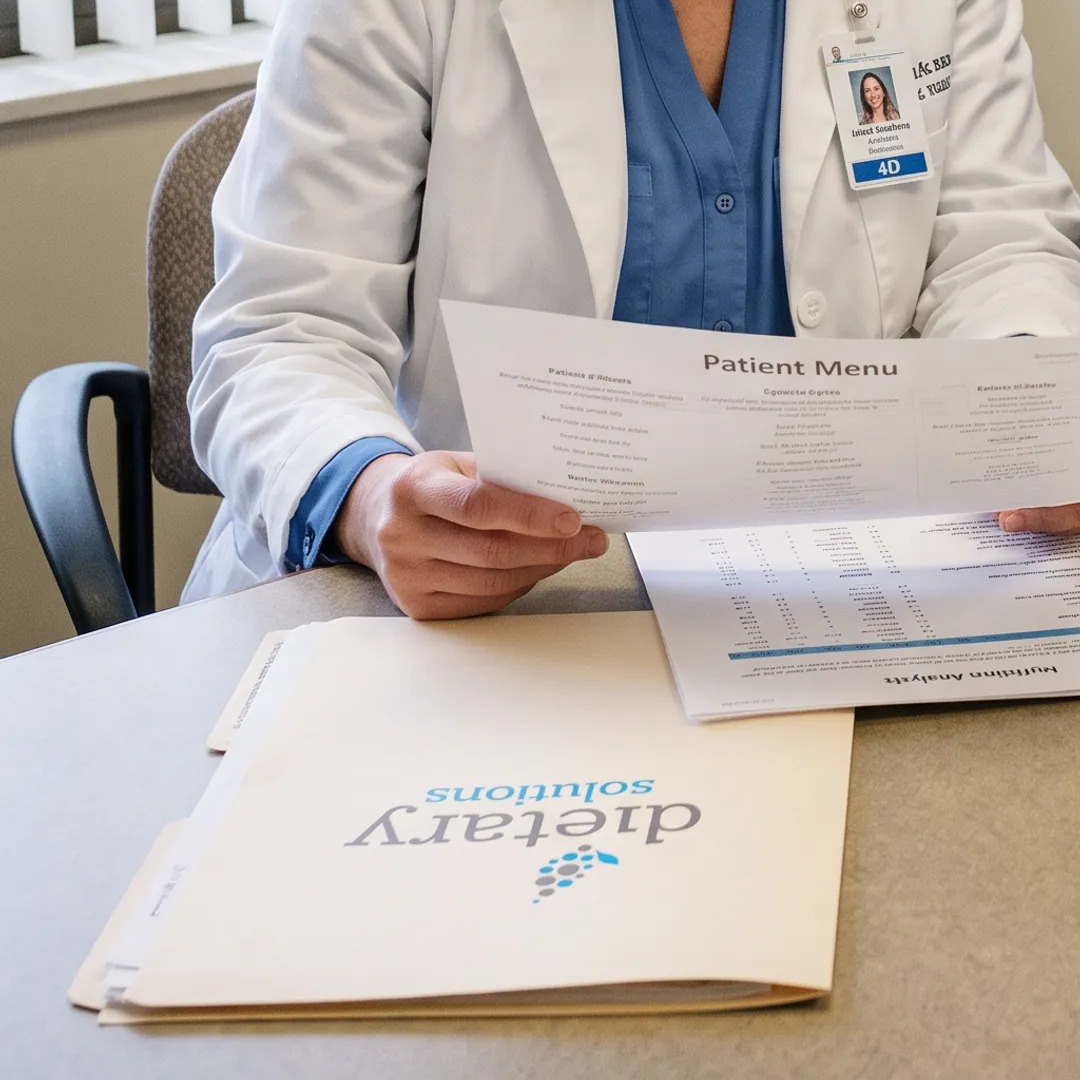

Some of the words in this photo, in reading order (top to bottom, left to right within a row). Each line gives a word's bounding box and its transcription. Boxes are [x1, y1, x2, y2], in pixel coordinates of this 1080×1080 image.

[878, 159, 901, 176] 4D
[704, 354, 805, 376] Patient
[815, 360, 898, 377] Menu
[424, 779, 655, 806] solutions
[343, 803, 701, 848] dietary
